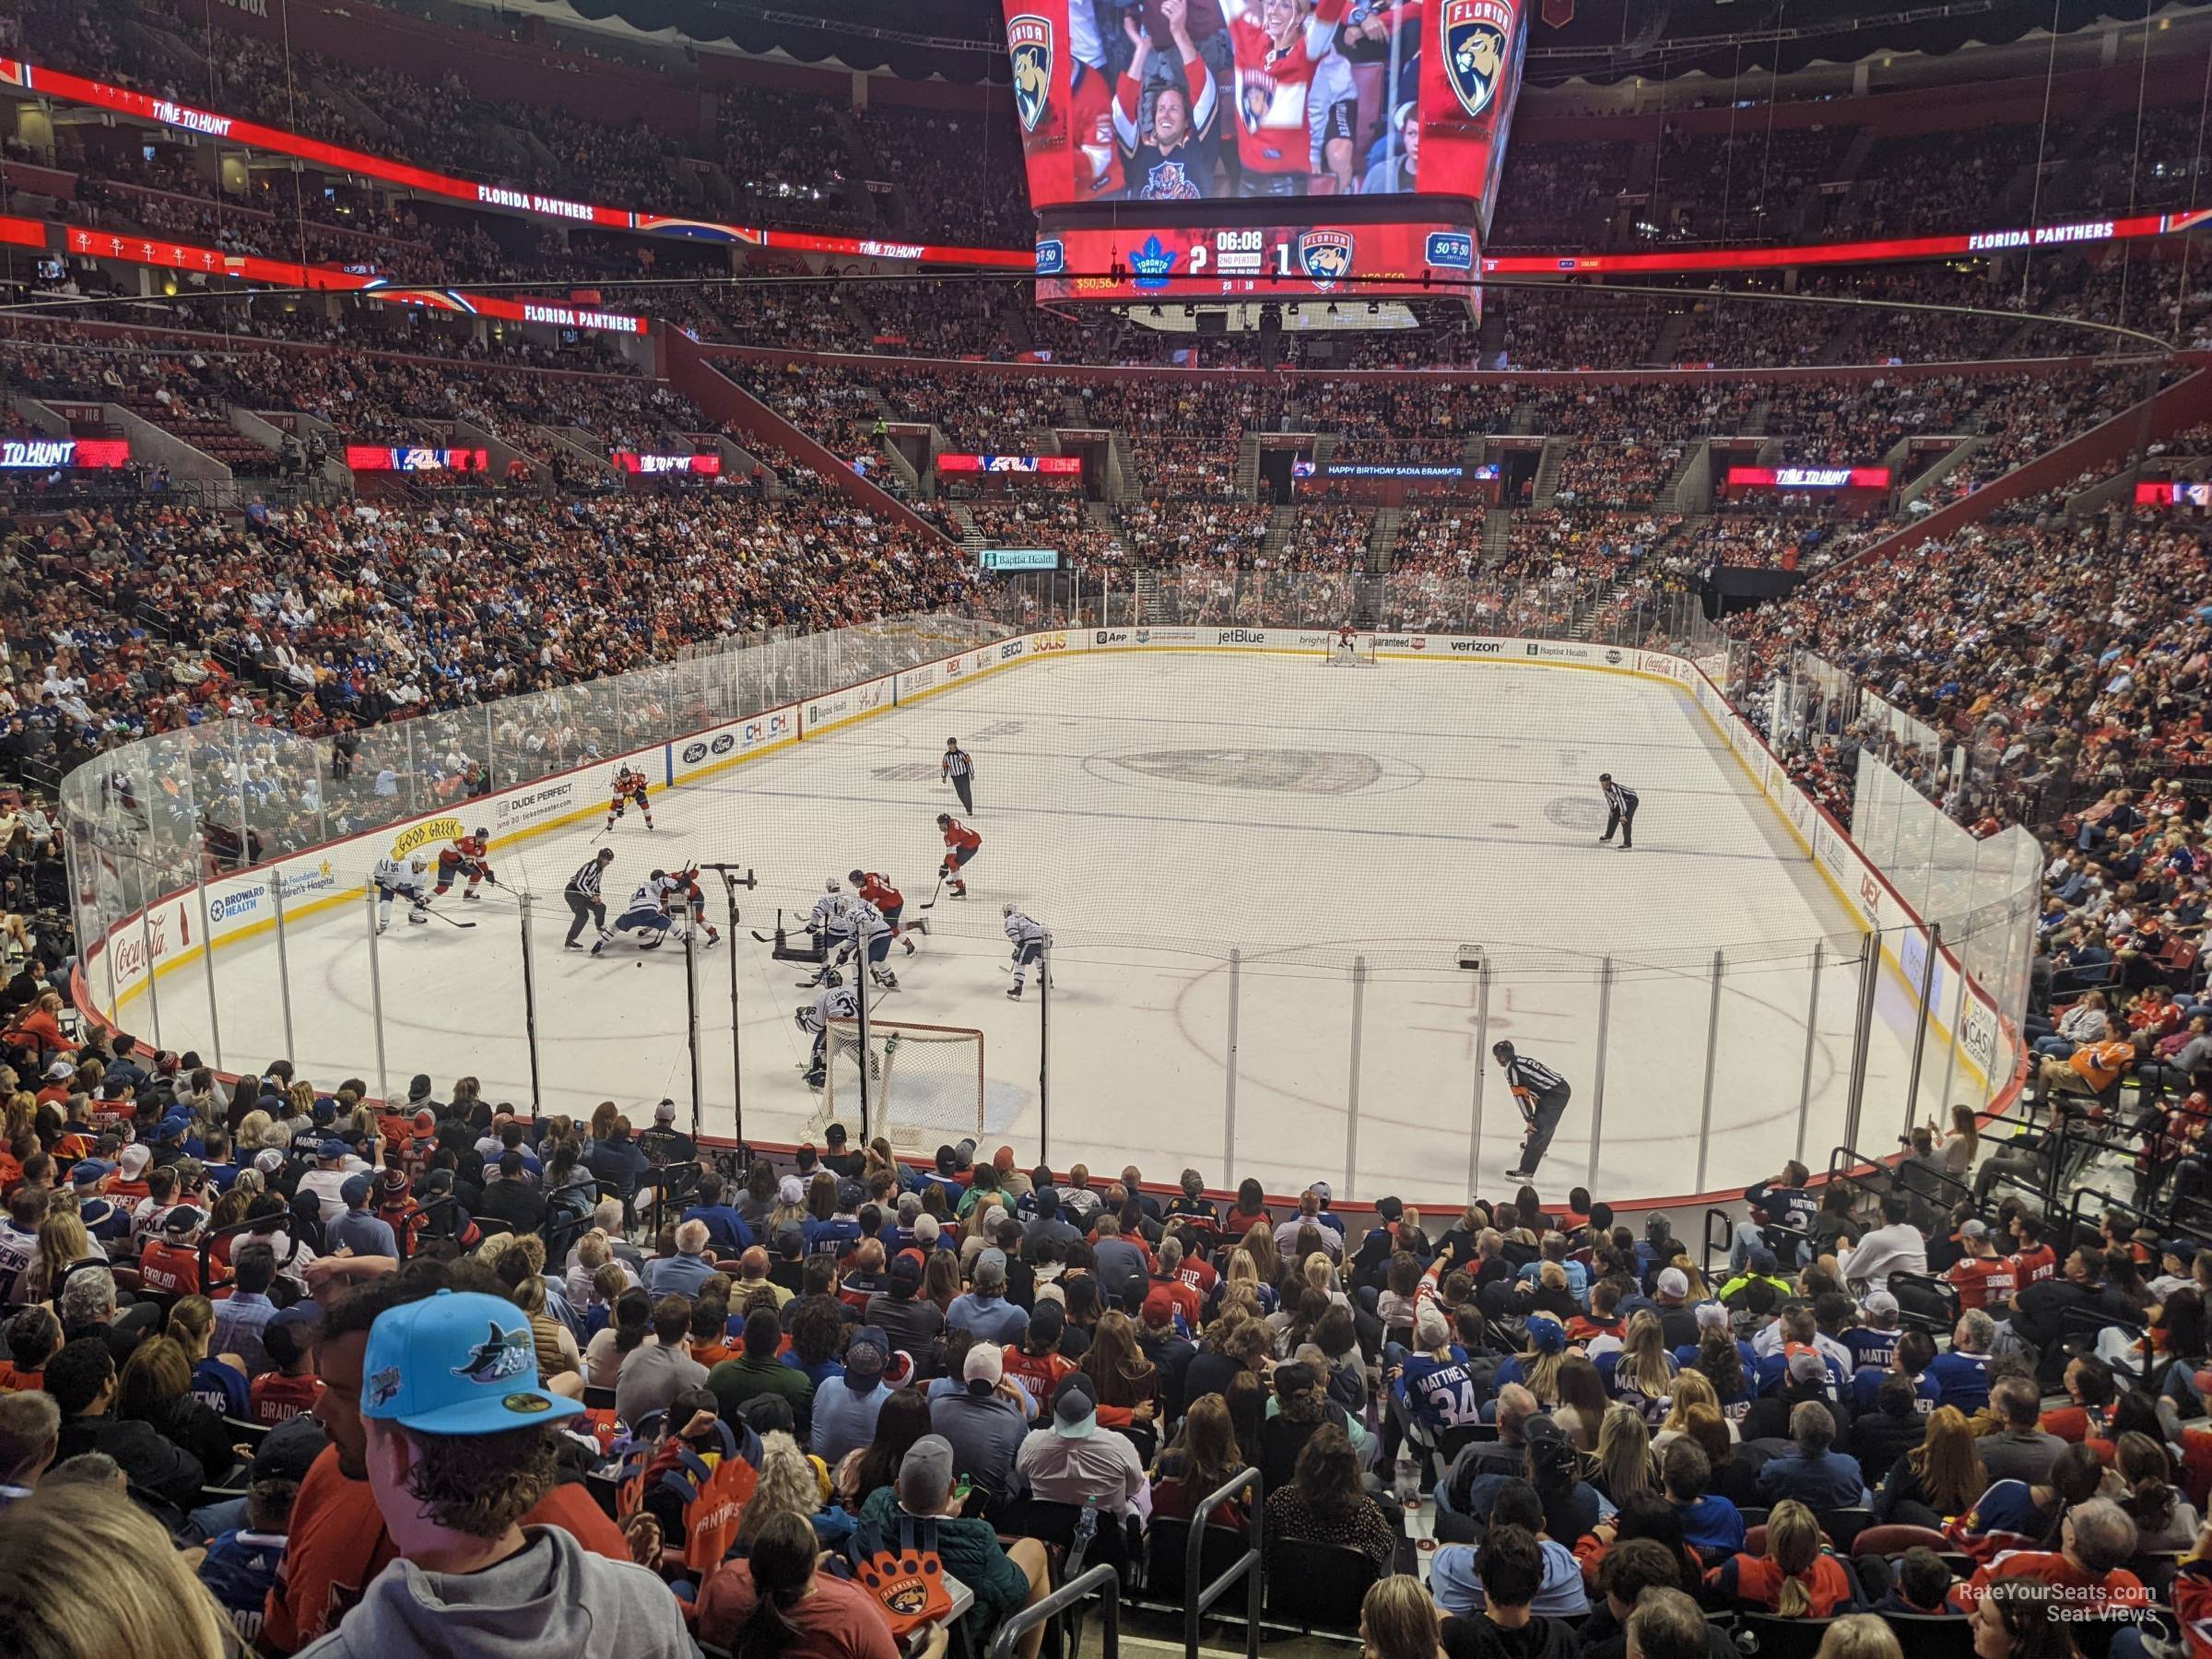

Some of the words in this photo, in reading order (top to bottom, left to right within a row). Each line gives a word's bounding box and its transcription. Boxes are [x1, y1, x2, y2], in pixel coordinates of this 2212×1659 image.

[1454, 5, 1509, 30] FLORIDA
[152, 101, 180, 123] TIME
[183, 111, 198, 127] TO
[199, 115, 231, 136] HUNT
[478, 185, 530, 210] FLORIDA
[534, 196, 594, 220] PANTHERS
[1218, 230, 1262, 251] 06:08
[1306, 235, 1346, 246] FLORIDA
[1969, 231, 2030, 251] FLORIDA
[2035, 222, 2114, 244] PANTHERS
[858, 241, 881, 254] TIME
[883, 245, 897, 256] TO
[897, 247, 924, 258] HUNT
[1045, 250, 1056, 262] 50
[1435, 241, 1450, 254] 50
[1459, 244, 1469, 256] 50
[1137, 259, 1168, 269] TORONTO
[1218, 255, 1232, 265] 2ND
[1233, 255, 1259, 265] PERIOD
[1277, 243, 1291, 276] 1
[524, 305, 575, 325] FLORIDA
[579, 311, 637, 332] PANTHERS
[85, 408, 100, 421] 118
[282, 417, 294, 429] 119
[3, 442, 26, 463] TO
[26, 441, 76, 464] HUNT
[1328, 465, 1355, 475] HAPPY
[1356, 466, 1395, 475] BIRTHDAY
[1396, 467, 1420, 476] SADIA
[1421, 467, 1463, 477] BRAMMER
[1776, 468, 1804, 484] TIME
[1805, 470, 1820, 483] TO
[1820, 470, 1851, 483] HUNT
[999, 556, 1026, 566] Baptist
[1029, 555, 1053, 564] Health
[1032, 632, 1066, 653] SOLIS
[1218, 629, 1265, 644] jetBlue
[1368, 637, 1409, 648] guaranteed
[1411, 638, 1426, 647] Rate
[1001, 641, 1022, 659] GEICO
[1451, 640, 1500, 653] verizon
[1540, 646, 1564, 656] Baptist
[1566, 648, 1588, 657] Health
[947, 657, 961, 674] DEX
[746, 722, 761, 740] CH
[714, 735, 732, 753] Ford
[687, 745, 704, 762] Ford
[512, 794, 535, 810] DUDE
[536, 782, 572, 802] PERFECT
[523, 799, 572, 820] ticketmaster.com
[429, 820, 457, 838] GREEK
[398, 828, 425, 852] GOOD
[288, 869, 321, 885] Foundation
[307, 875, 335, 892] Hospital
[224, 886, 265, 905] BROWARD
[1861, 871, 1882, 913] DEX
[226, 899, 257, 917] HEALTH
[837, 996, 859, 1017] 36
[143, 1265, 177, 1289] EKBLAD
[261, 1400, 299, 1420] BRADY
[1430, 1379, 1480, 1426] 34
[884, 1579, 918, 1597] FLORIDA
